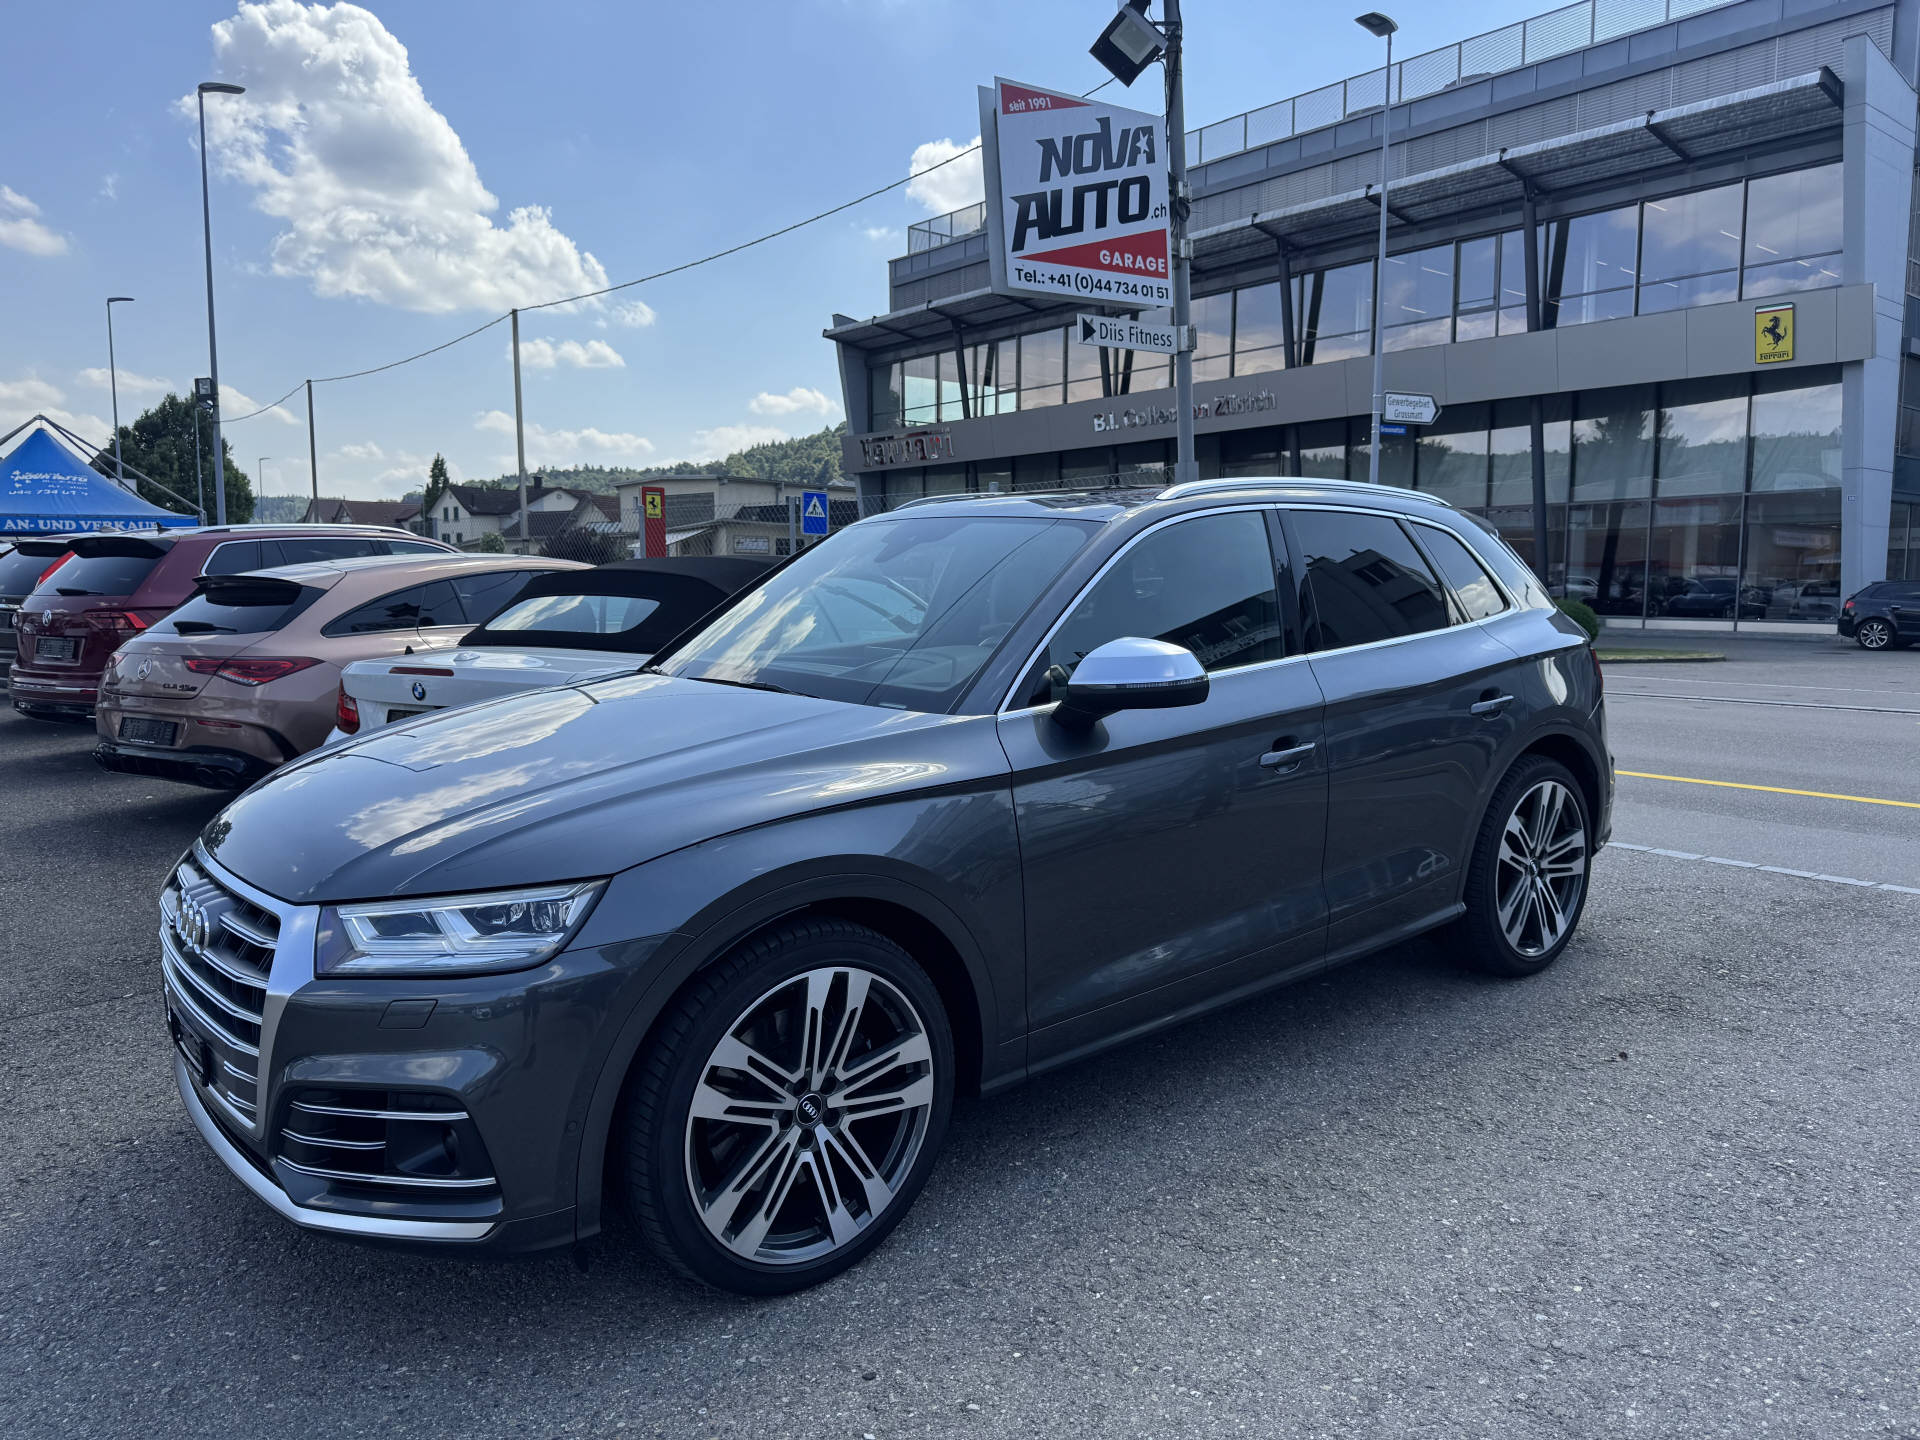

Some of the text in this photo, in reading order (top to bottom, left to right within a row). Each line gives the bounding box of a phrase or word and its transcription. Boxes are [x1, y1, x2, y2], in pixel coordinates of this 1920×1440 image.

[1009, 96, 1052, 112] seit 1991
[1036, 116, 1156, 183] NOVA
[1009, 175, 1151, 253] AUTO
[1100, 249, 1166, 273] GARAGE
[1015, 267, 1046, 284] Tel.:
[1048, 273, 1071, 288] +41
[1114, 281, 1138, 296] 734
[1141, 286, 1154, 298] 01
[1156, 287, 1169, 299] 51
[1099, 322, 1172, 347] Diis Fitness
[1760, 351, 1789, 360] Ferrari
[3, 519, 34, 531] AN-
[37, 519, 76, 531] UND
